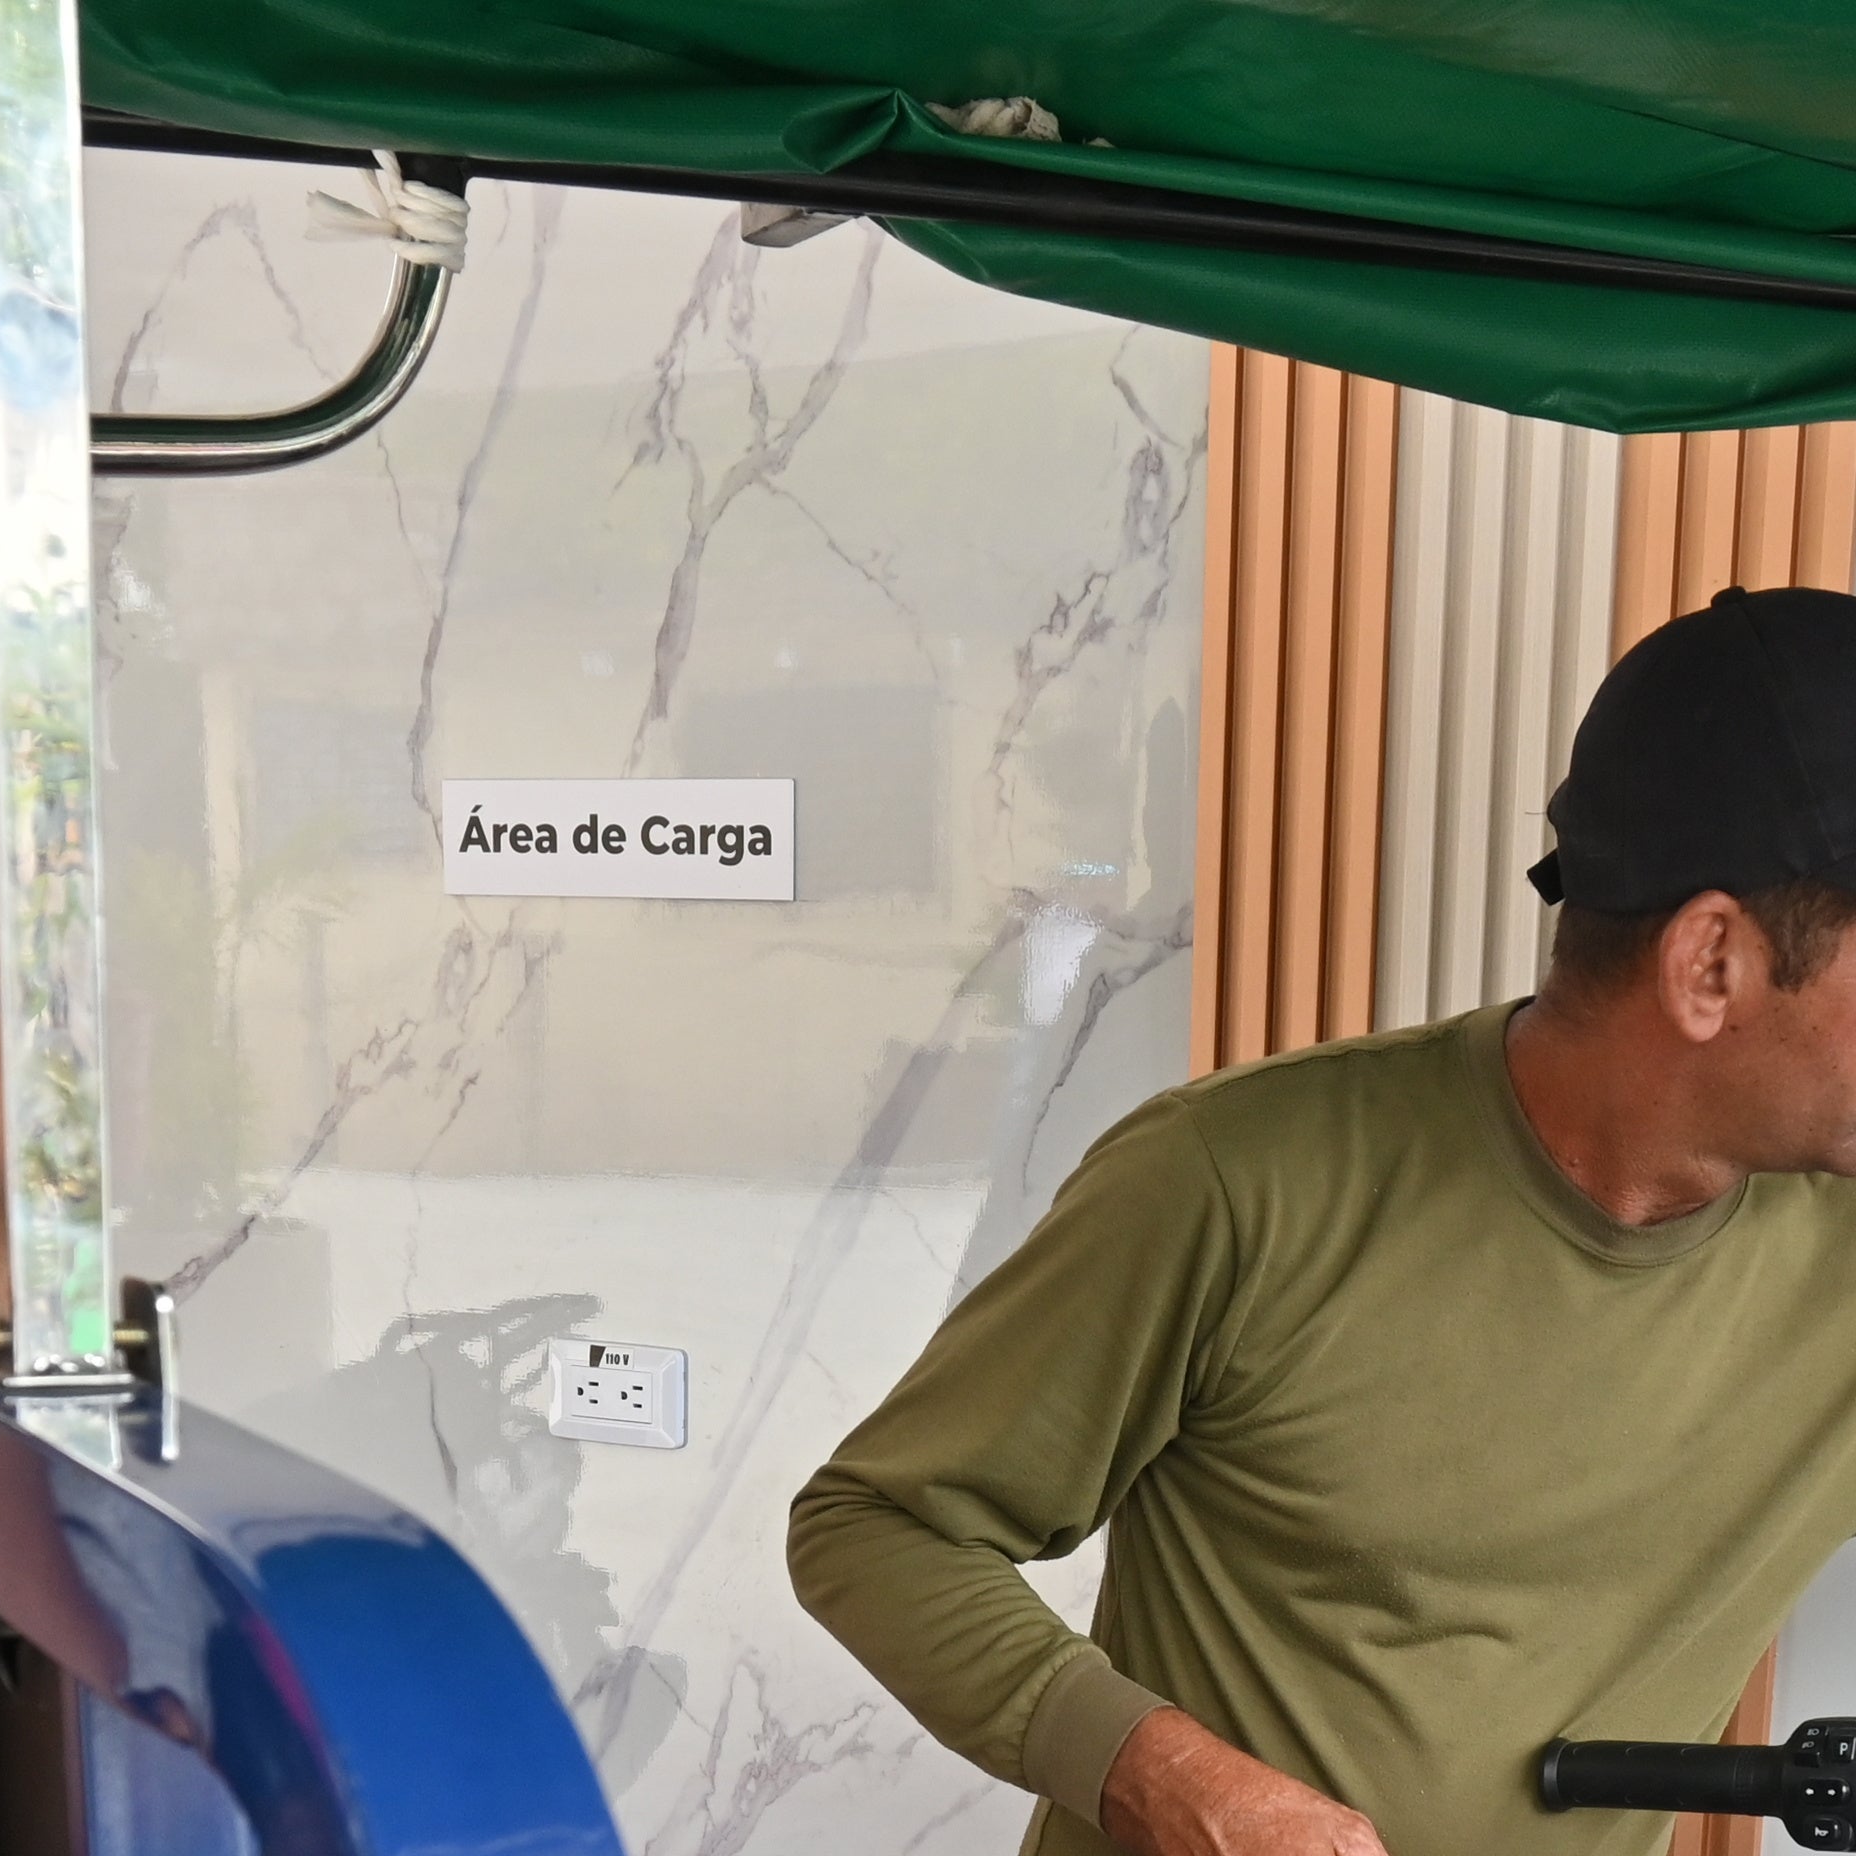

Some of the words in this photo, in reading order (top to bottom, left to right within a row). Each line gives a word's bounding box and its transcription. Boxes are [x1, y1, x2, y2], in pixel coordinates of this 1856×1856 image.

[458, 804, 558, 854] Área
[572, 814, 627, 855] de
[641, 815, 772, 866] Carga
[605, 1353, 620, 1365] 110
[623, 1354, 630, 1366] V
[1839, 1742, 1849, 1756] P
